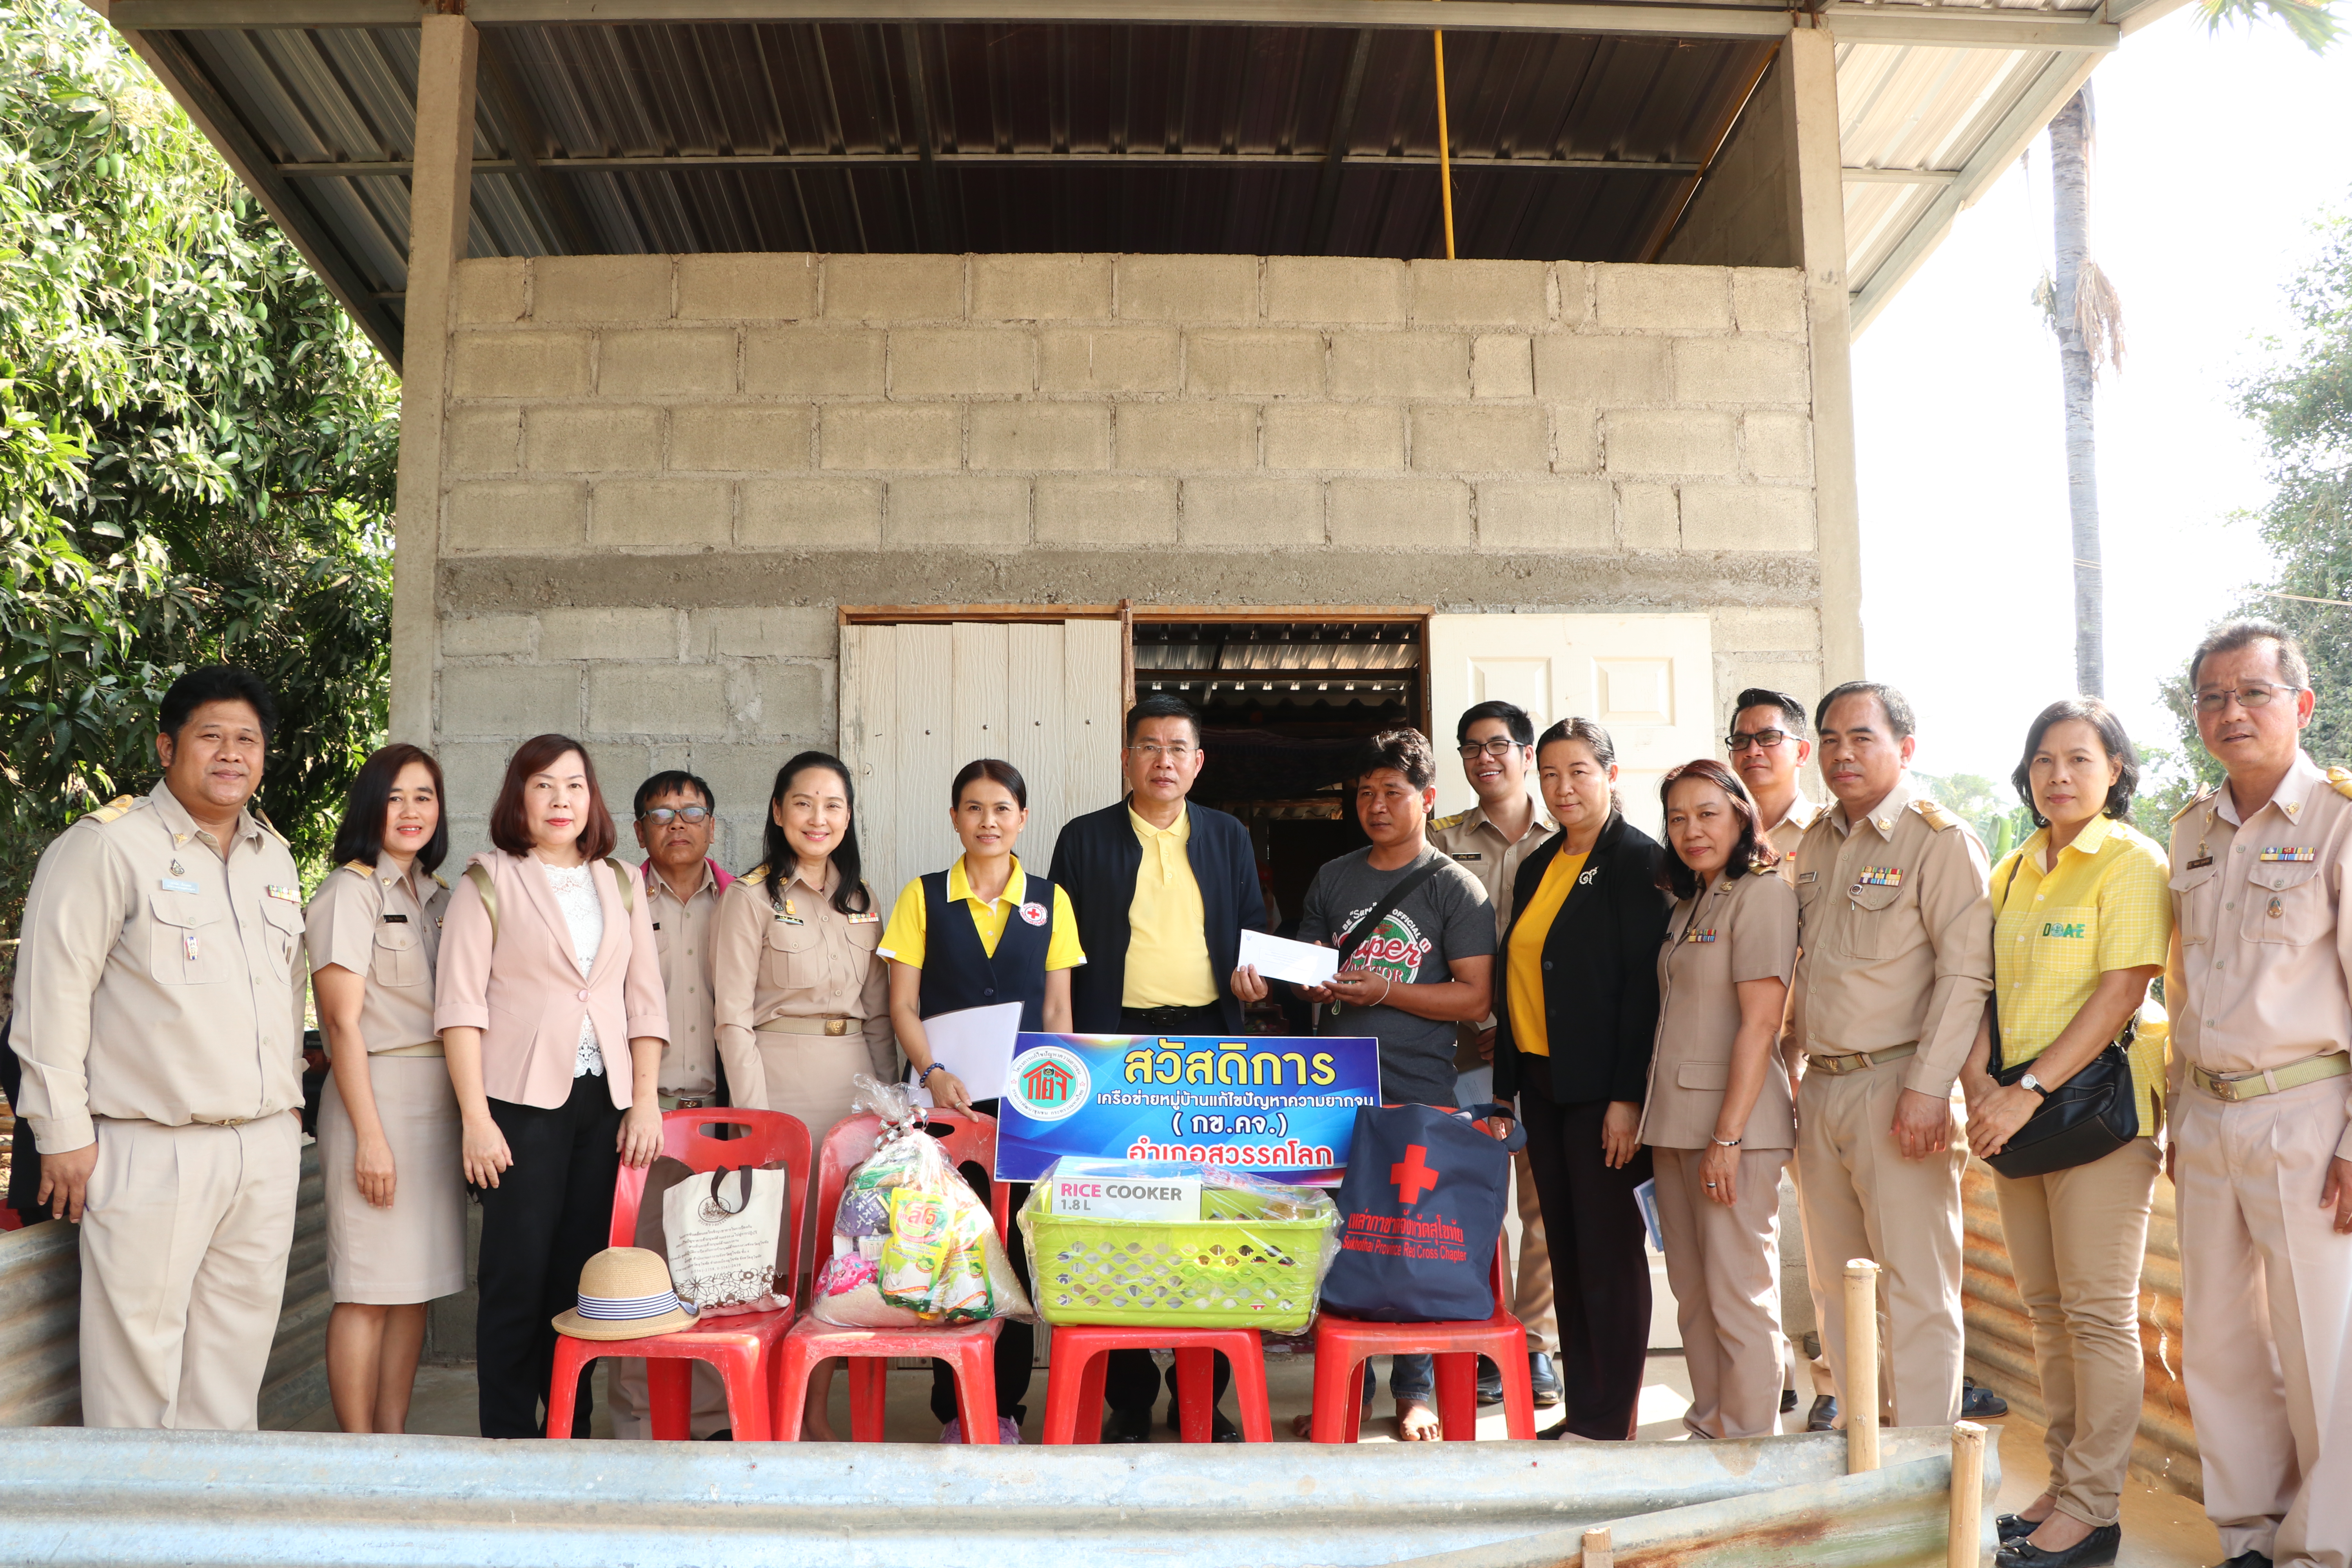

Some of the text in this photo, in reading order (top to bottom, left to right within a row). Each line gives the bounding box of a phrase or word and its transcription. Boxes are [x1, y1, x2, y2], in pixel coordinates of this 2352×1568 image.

[1342, 918, 1352, 931] BE
[1392, 909, 1421, 939] OFFICIAL
[1124, 1038, 1336, 1086] สวัสดิการ
[1097, 1089, 1374, 1111] เครือข่ายหมู่บ้านแก้ไขปัญหาความยากจน
[1061, 1183, 1182, 1201] RICE COOKER
[1061, 1199, 1091, 1210] 1.8 L
[871, 1201, 881, 1211] 2018
[1348, 1208, 1464, 1246] เหล่ากาชาดจังหวัดสุโขทัย
[1342, 1235, 1467, 1263] Sukhothai Province Red Cross Chapter
